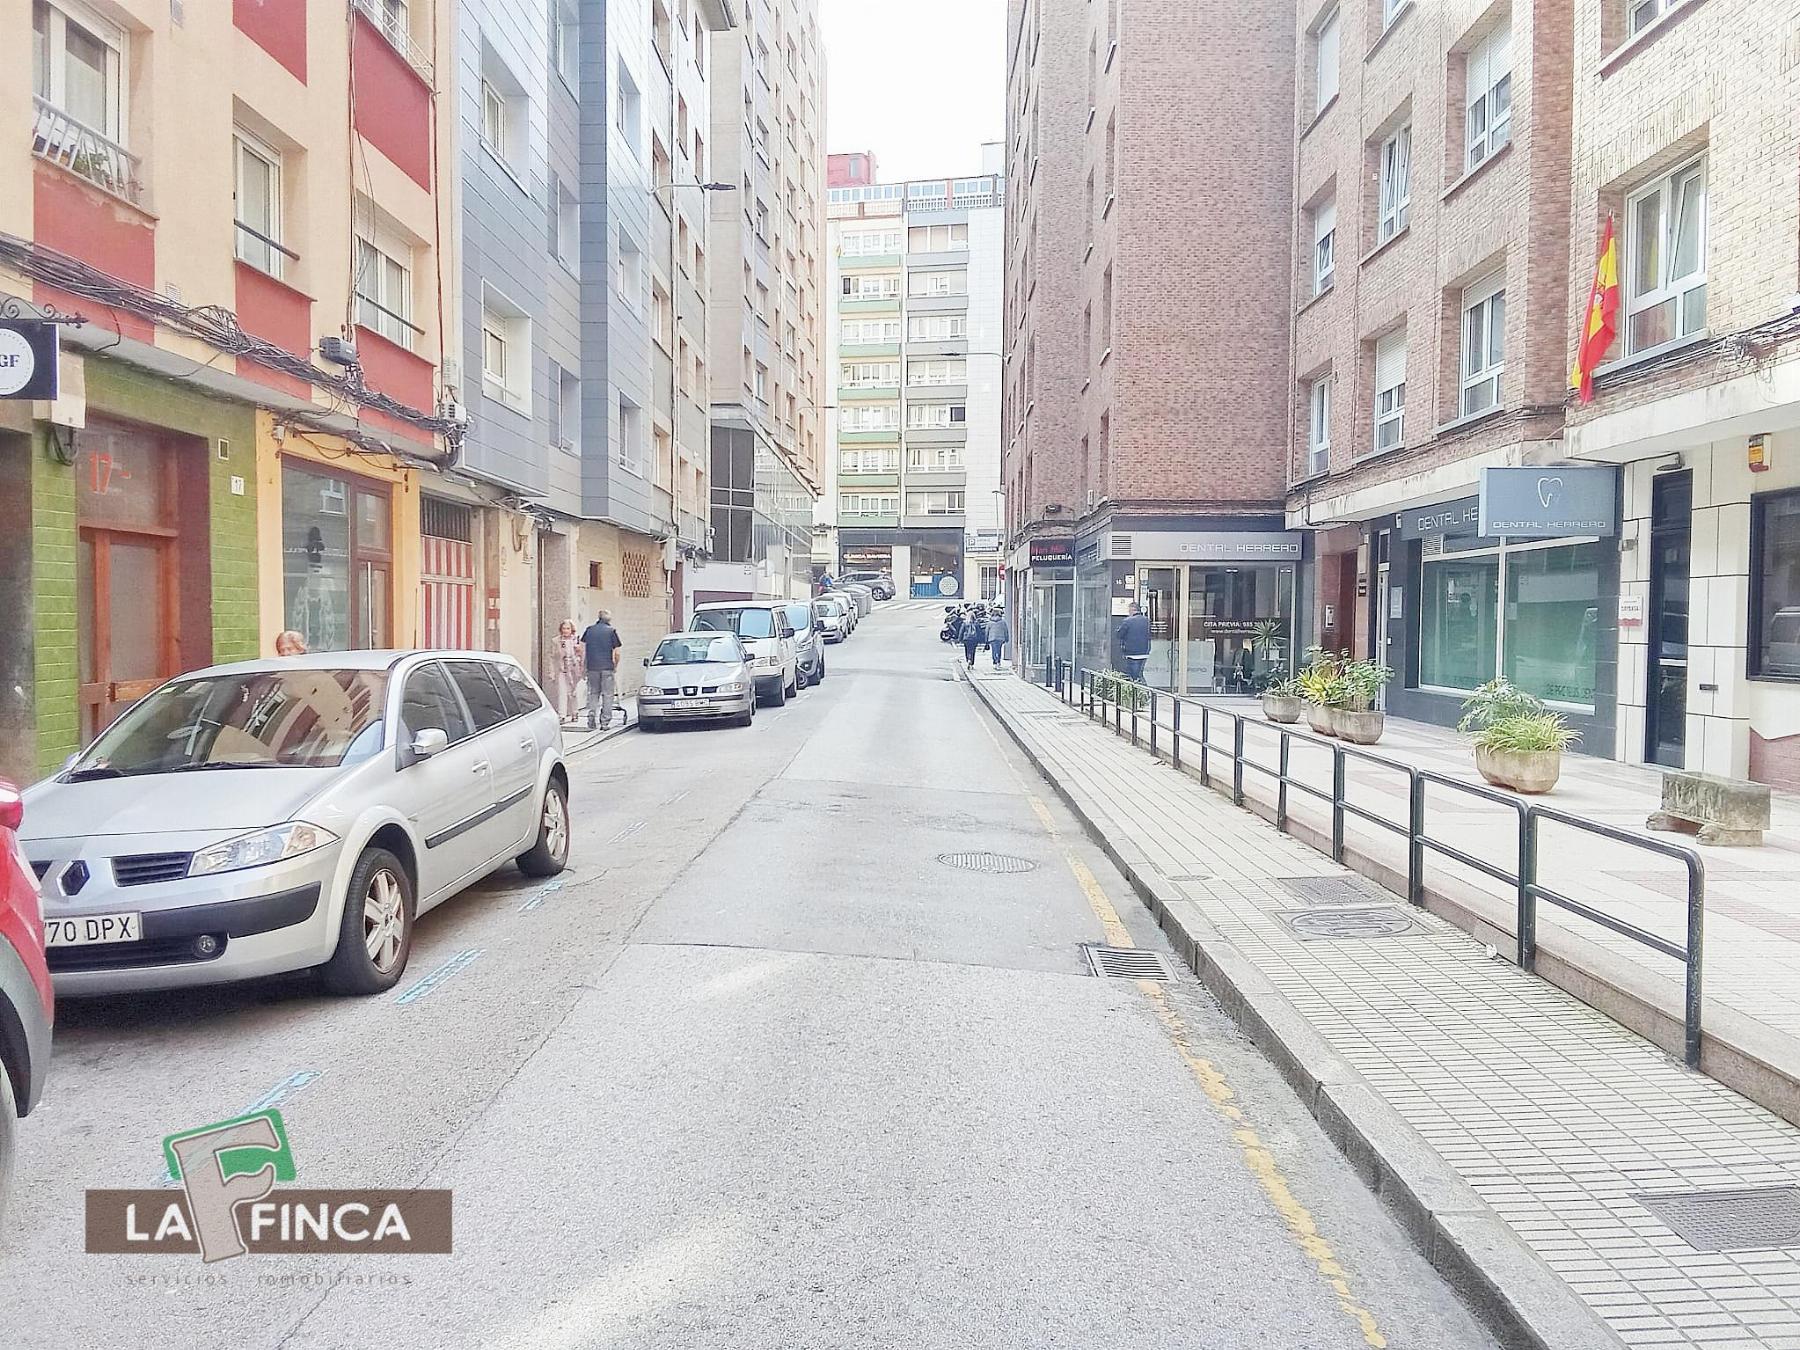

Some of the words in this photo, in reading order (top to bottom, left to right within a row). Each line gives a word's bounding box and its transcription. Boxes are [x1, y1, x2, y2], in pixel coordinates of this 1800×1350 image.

[1417, 511, 1460, 532] DENTAL
[1492, 520, 1543, 529] DENTAL
[1546, 520, 1606, 529] HERRERO
[1179, 543, 1232, 553] DENTAL
[1236, 543, 1299, 553] HERRERO
[1031, 552, 1073, 562] PELUQUERÍA
[44, 921, 77, 943] 70
[86, 916, 132, 941] DPX
